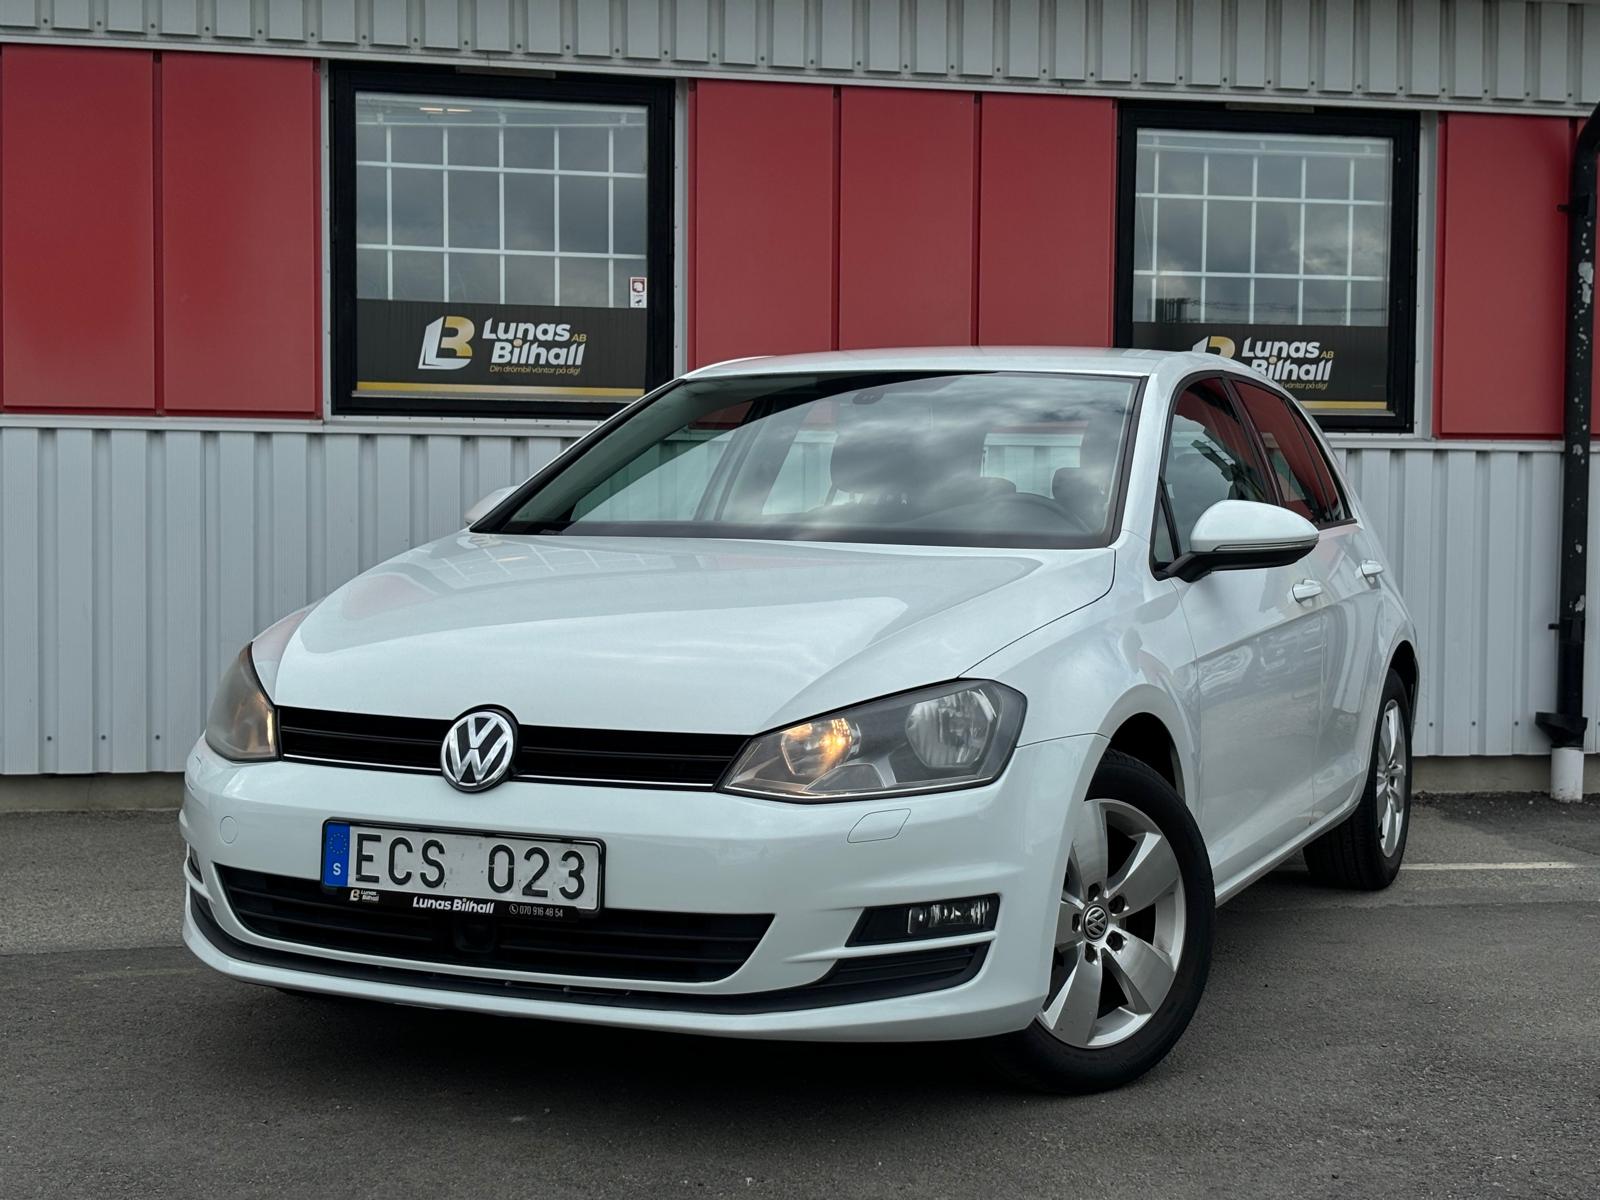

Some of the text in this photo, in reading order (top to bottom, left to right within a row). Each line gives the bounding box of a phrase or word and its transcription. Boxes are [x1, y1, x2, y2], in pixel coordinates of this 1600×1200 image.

[482, 318, 587, 343] Lunas AB
[491, 338, 586, 365] Bilhall
[1242, 337, 1334, 359] Lunas AB
[489, 365, 502, 373] Din
[555, 367, 566, 375] på
[566, 367, 581, 376] dig!
[1251, 356, 1333, 381] Bilhall
[332, 863, 342, 876] S
[355, 833, 586, 900] ECS 023
[362, 894, 380, 902] Bilhall
[412, 896, 495, 914] Lunas Bilhall
[519, 905, 563, 918] 070 916 48 54
